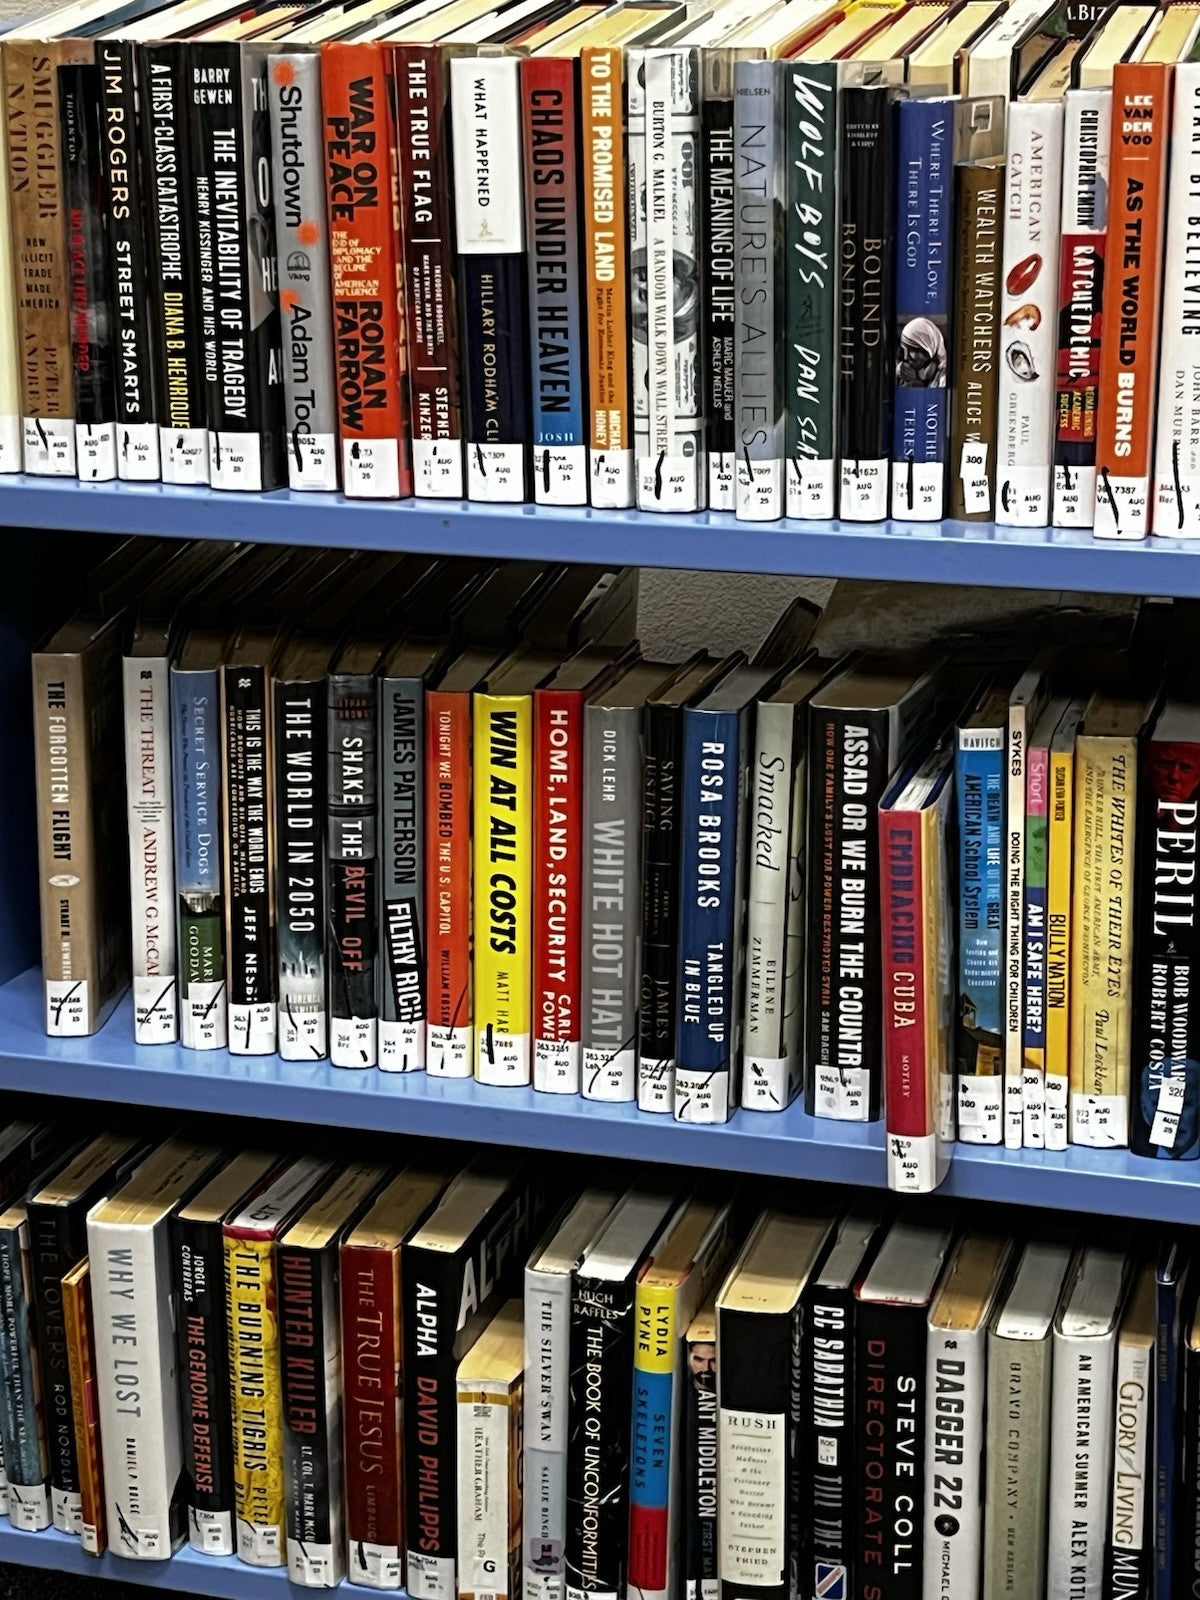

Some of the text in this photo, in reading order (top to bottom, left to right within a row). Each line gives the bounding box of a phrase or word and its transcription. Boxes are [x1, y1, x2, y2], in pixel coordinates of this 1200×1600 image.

[9, 84, 29, 192] NATION
[33, 57, 57, 217] SMUGGLER
[67, 94, 76, 161] THORNTON
[104, 50, 129, 219] JIM ROGERS
[151, 65, 182, 280] A FIRST-CLASS CATASTROPHE
[280, 86, 304, 227] Shutdown
[327, 118, 354, 221] PEACE
[349, 77, 378, 208] WAR ON
[408, 60, 432, 222] THE TRUE FLAG
[474, 79, 489, 206] WHAT HAPPENED
[591, 52, 614, 281] TO THE PROMISED LAND
[793, 74, 832, 288] WOLF BOYS
[1009, 153, 1023, 220] CATCH
[1029, 131, 1043, 241] AMERICAN
[1077, 110, 1099, 226] CHRISTOPHER EMDIN
[116, 241, 139, 412] STREET SMARTS
[197, 177, 217, 381] HENRY KISSINGER AND HIS WORLD
[213, 128, 246, 417] THE INEVITABILITY OF TRAGEDY
[531, 90, 570, 412] CHAOS UNDER HEAVEN
[740, 126, 771, 448] NATURE'S ALLIES
[972, 189, 996, 372] WEALTH WATCHERS
[1069, 246, 1094, 377] RATCHETDEMIC
[1115, 178, 1143, 456] AS THE WORLD BURNS
[290, 303, 312, 383] Adam
[336, 303, 362, 432] FARROW
[360, 302, 386, 409] RONAN
[480, 274, 500, 412] HILLARY RODHAM
[965, 455, 982, 464] 300
[1008, 393, 1017, 466] GREENBERG
[1021, 415, 1030, 445] PAUL
[48, 682, 71, 860] THE FORGOTTEN FLIGHT
[140, 685, 153, 722] THE
[141, 727, 155, 797] THREAT
[1012, 731, 1021, 776] SYKES
[193, 697, 211, 874] SECRET SERVICE DOGS
[286, 699, 314, 931] THE WORLD IN 2050
[393, 693, 415, 883] JAMES PATTERSON
[490, 712, 516, 954] WIN AT ALL COSTS
[547, 711, 567, 982] HOME, LAND, SECURITY
[698, 743, 724, 907] ROSA BROOKS
[756, 752, 784, 875] Smacked
[840, 725, 868, 978] ASSAD OR WE BURN THE
[388, 903, 417, 964] FILTHY
[593, 820, 624, 978] WHITE HOT
[890, 830, 915, 1027] EMBRACING CUBA
[1009, 832, 1020, 1032] DOING THE RIGHT THING FOR CHILDREN
[1108, 754, 1126, 996] THE WHITES OF THEIR EYES
[1154, 799, 1197, 935] PERIL
[749, 937, 763, 1033] ZIMMERMAN
[1049, 914, 1066, 1008] BULLY NATION
[902, 1055, 910, 1097] MOTLEY
[108, 1249, 140, 1417] WHY WE LOST
[182, 1245, 193, 1301] CONTRERAS
[194, 1256, 205, 1285] JORGE
[282, 1256, 316, 1433] HUNTER KILLER
[416, 1283, 437, 1355] ALPHA
[639, 1307, 650, 1351] PYNE
[656, 1307, 669, 1356] LYDIA
[187, 1317, 213, 1493] THE GENOME DEFENSE
[236, 1253, 267, 1470] THE BURNING TIGRIS
[354, 1269, 384, 1473] THE TRUE JESUS
[540, 1301, 552, 1442] THE SILVER SWAN
[814, 1305, 844, 1427] CC SABATHIA
[934, 1359, 965, 1509] DAGGER 22
[1075, 1355, 1092, 1508] AN AMERICAN SUMMER
[417, 1377, 440, 1551] DAVID PHILIPPS
[582, 1327, 603, 1590] THE BOOK OF UNCONFORMITIES
[865, 1340, 885, 1564] DIRECTORATE
[894, 1376, 916, 1574] STEVE COLL
[484, 1560, 496, 1572] G
